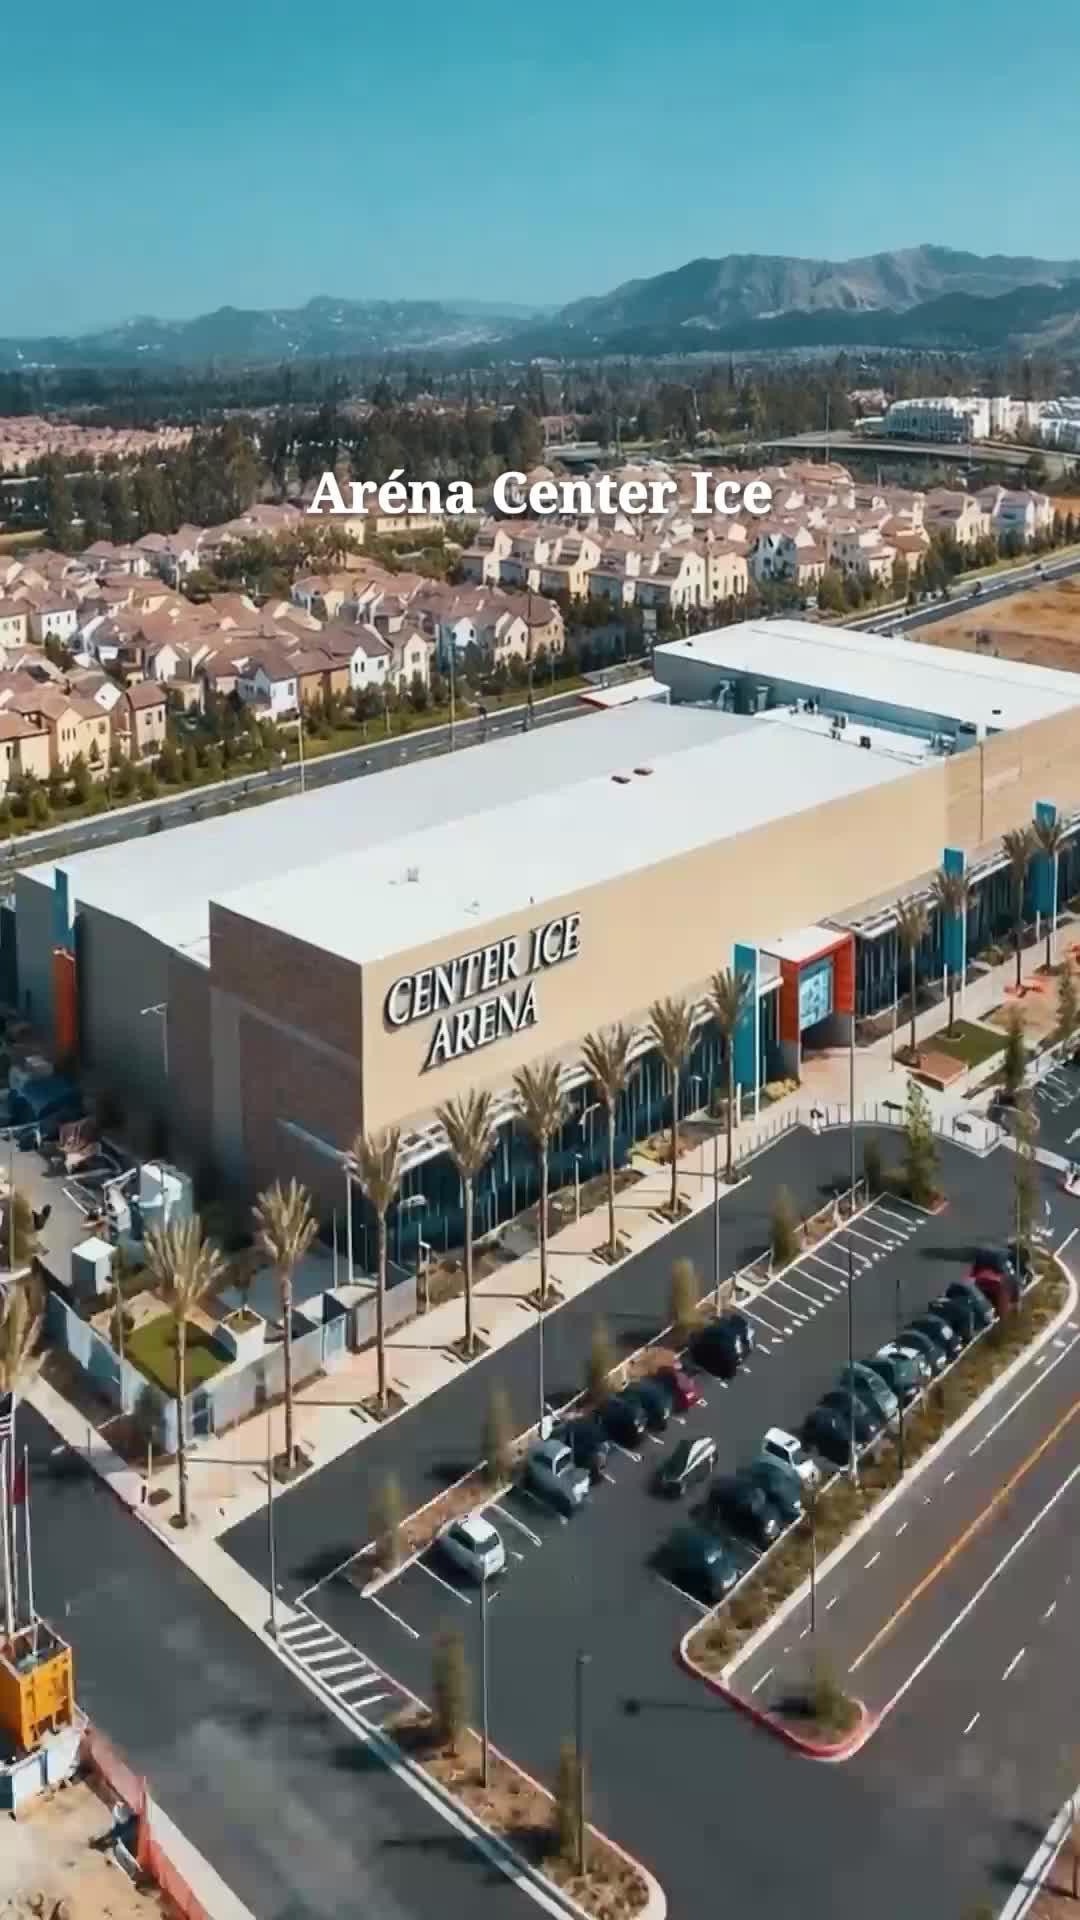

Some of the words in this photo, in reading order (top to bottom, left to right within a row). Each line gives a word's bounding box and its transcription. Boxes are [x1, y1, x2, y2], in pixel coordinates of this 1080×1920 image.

[384, 934, 523, 1027] CENTER
[529, 911, 583, 972] ICE
[422, 979, 539, 1071] ARENA
